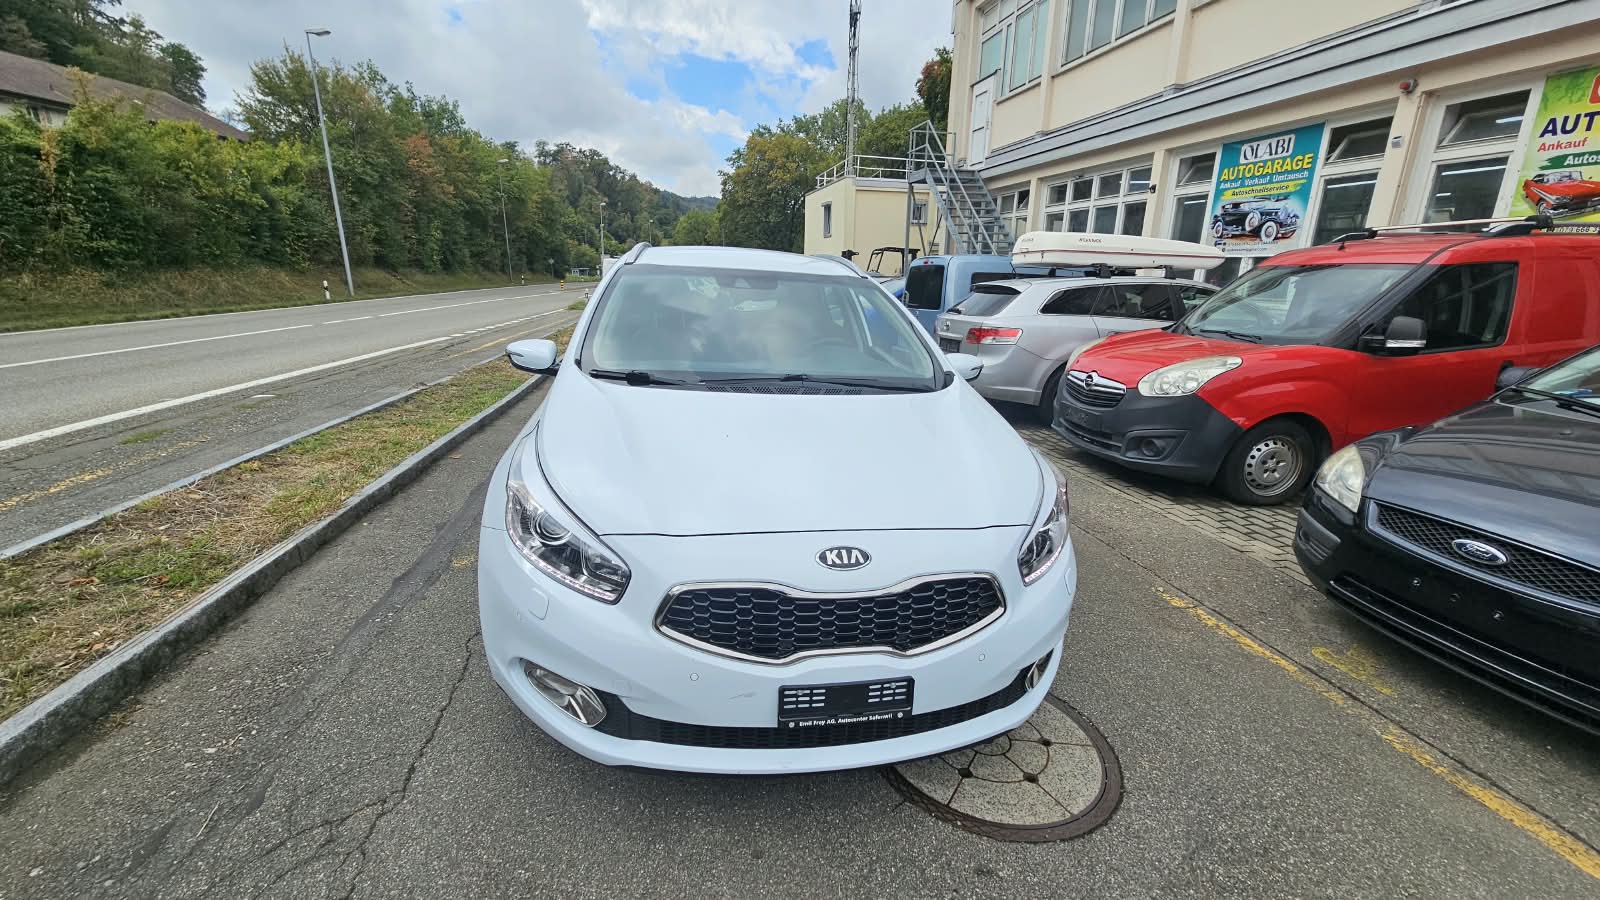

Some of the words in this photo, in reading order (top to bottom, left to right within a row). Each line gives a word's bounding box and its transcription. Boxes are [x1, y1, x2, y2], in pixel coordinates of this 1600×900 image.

[1537, 137, 1588, 152] Ankauf
[1220, 153, 1314, 181] AUTOGARAGE
[1220, 180, 1241, 189] Ankauf
[1245, 176, 1270, 187] Verkauf
[1273, 170, 1309, 182] Umtausch
[1231, 184, 1290, 196] Autoschnellservice
[825, 549, 865, 565] KIA
[837, 715, 869, 724] Autocenter
